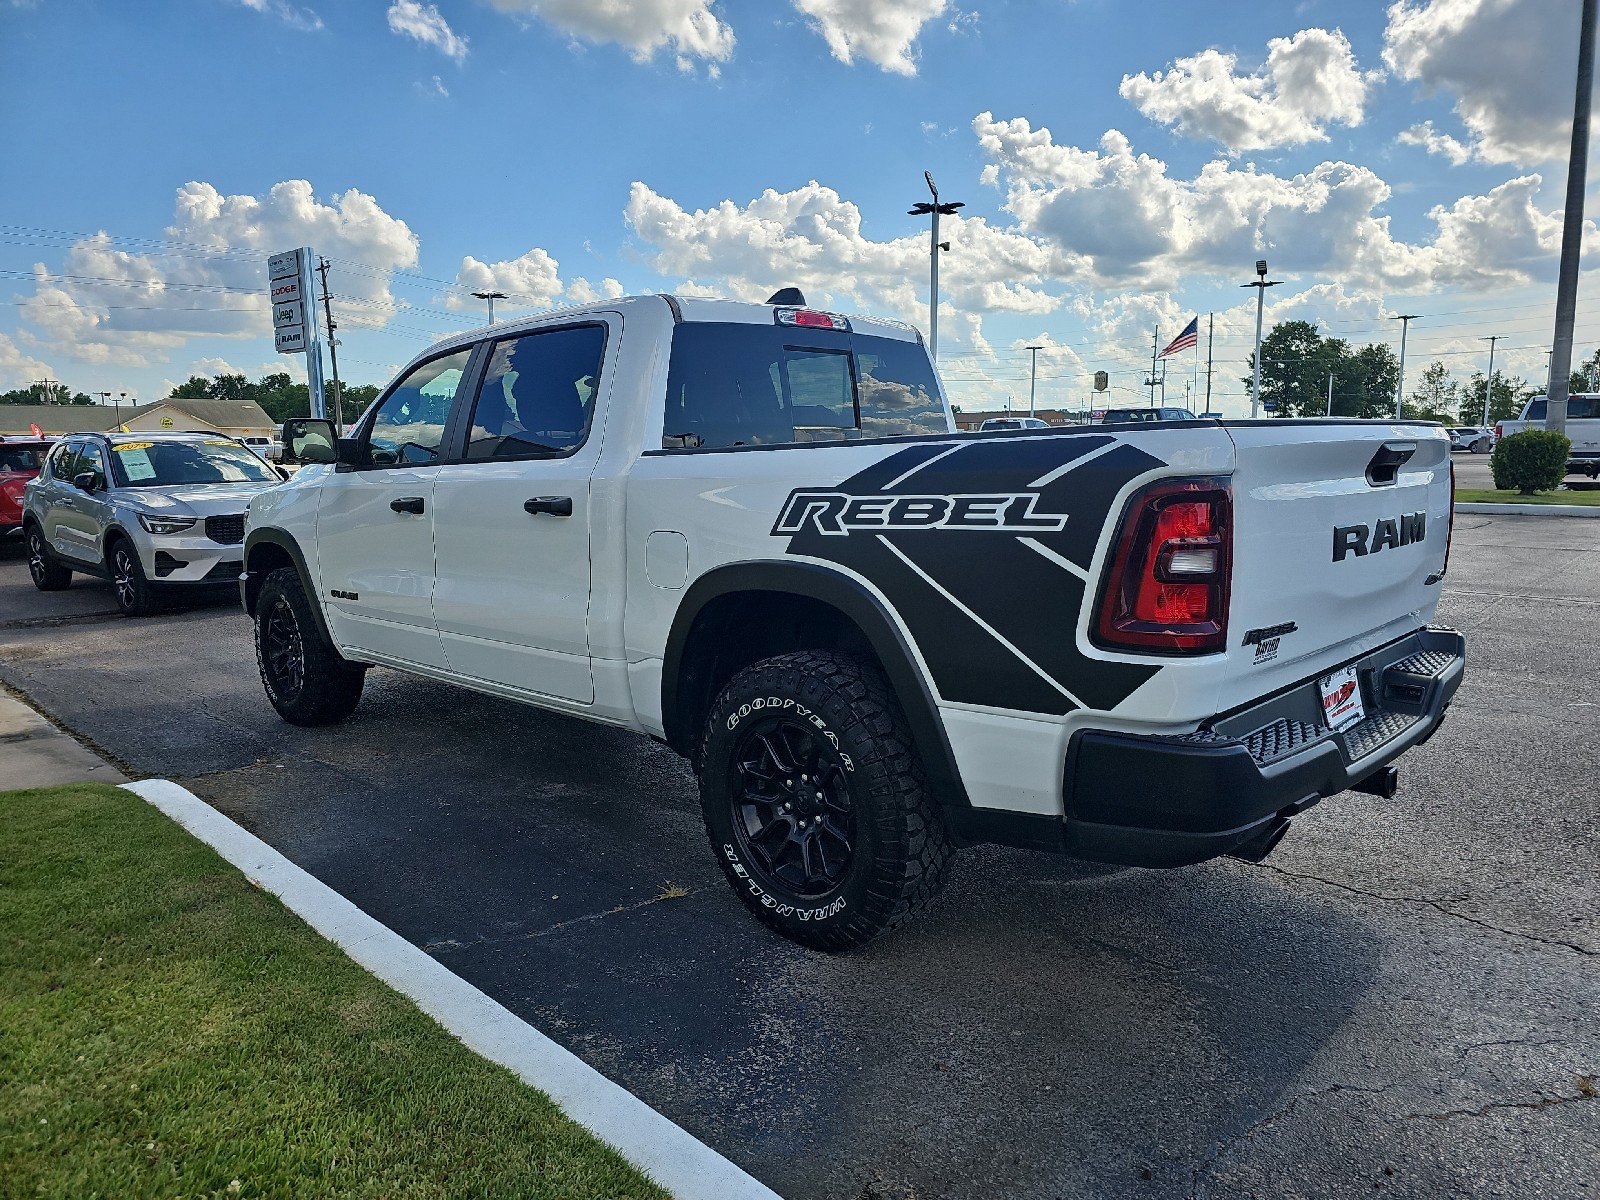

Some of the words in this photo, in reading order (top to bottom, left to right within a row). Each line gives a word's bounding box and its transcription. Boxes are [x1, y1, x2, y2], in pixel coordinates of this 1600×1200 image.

[271, 285, 297, 297] DODGE
[277, 308, 294, 322] Jeep
[281, 333, 301, 343] RAM
[772, 490, 1069, 536] REBEL
[1332, 510, 1426, 562] RAM
[727, 697, 854, 772] GOODYEAR
[724, 844, 847, 921] WRANGLER
